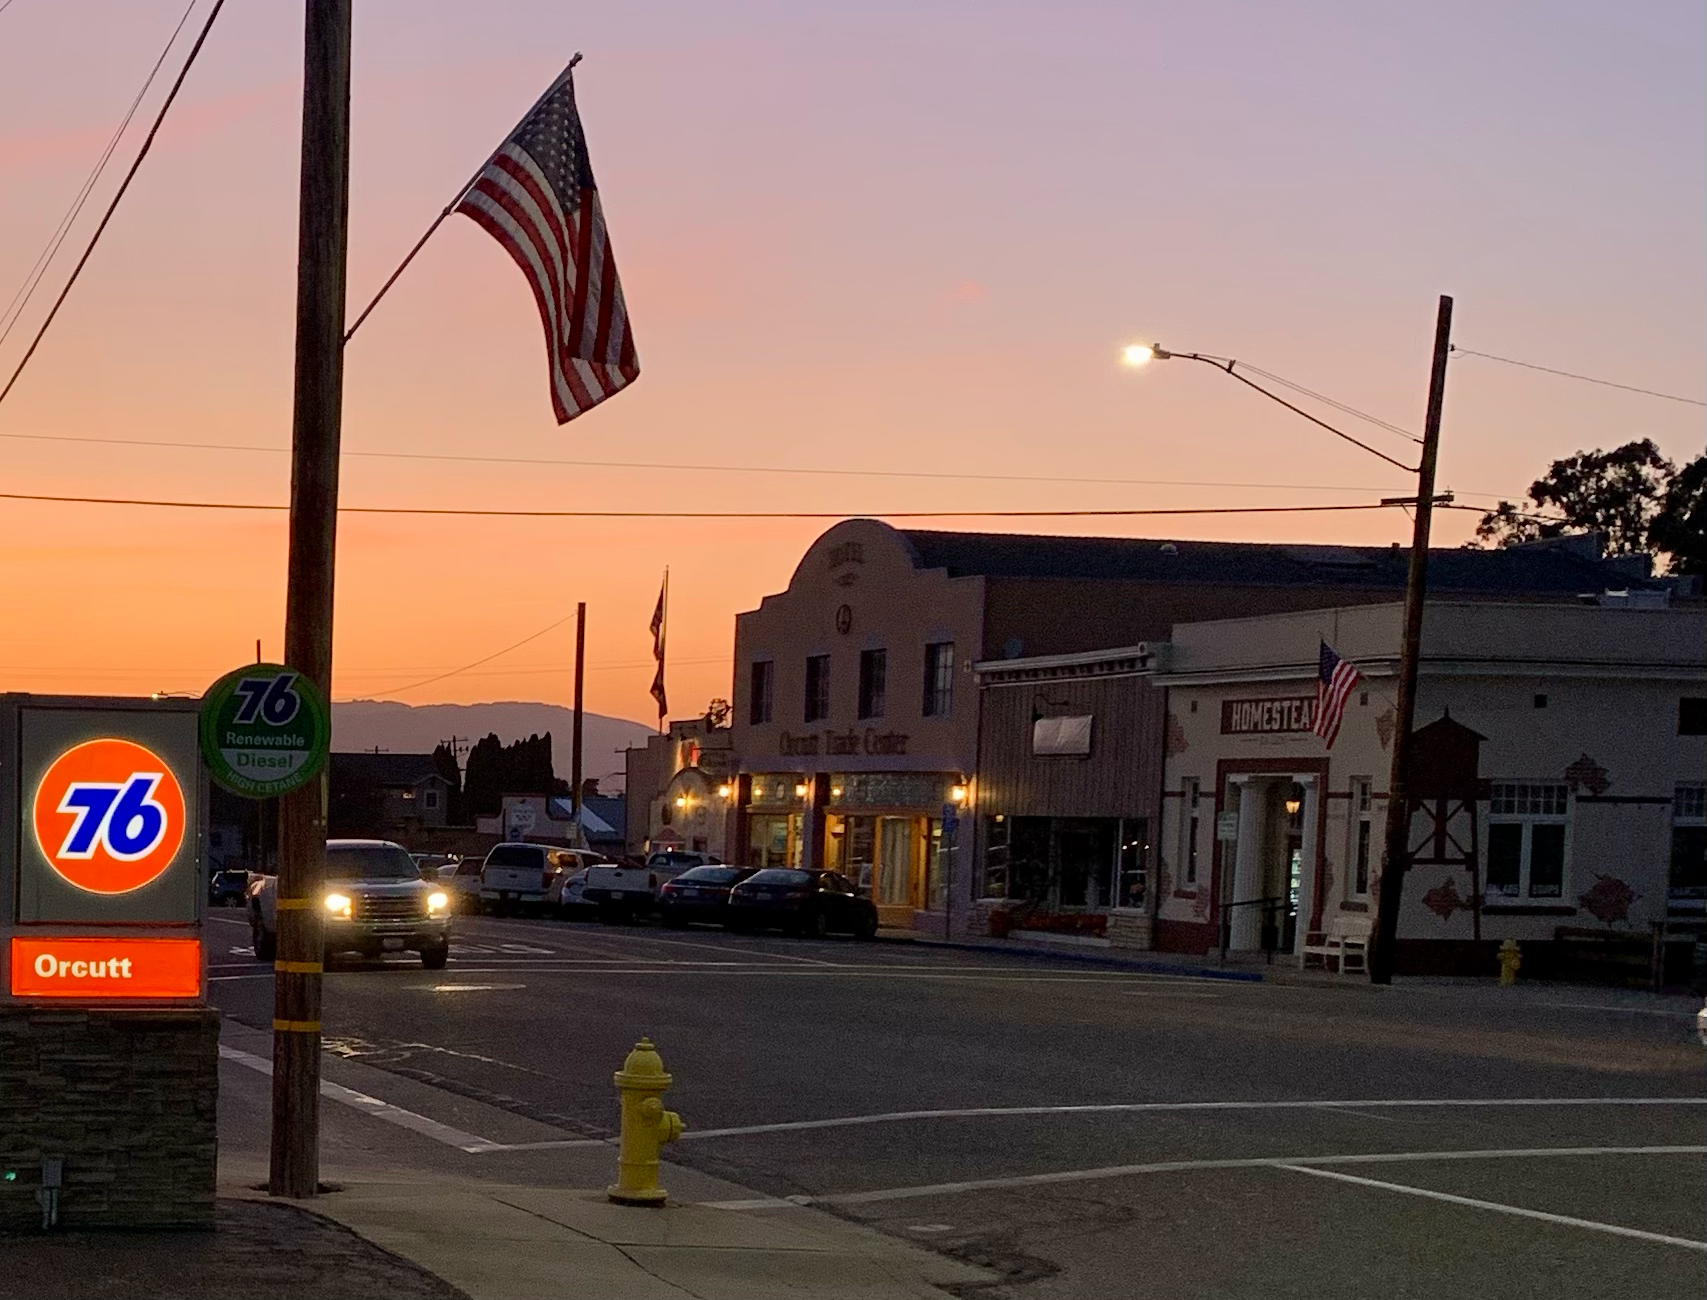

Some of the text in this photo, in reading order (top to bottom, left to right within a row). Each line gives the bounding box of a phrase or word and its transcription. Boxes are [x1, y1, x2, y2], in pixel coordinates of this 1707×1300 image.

[232, 672, 301, 726] 76
[1231, 699, 1317, 731] HOMESTEA
[226, 731, 305, 747] Renewable
[237, 753, 293, 768] Diesel
[227, 770, 255, 790] HIGH
[56, 772, 168, 862] 76
[34, 954, 132, 979] Orcutt
